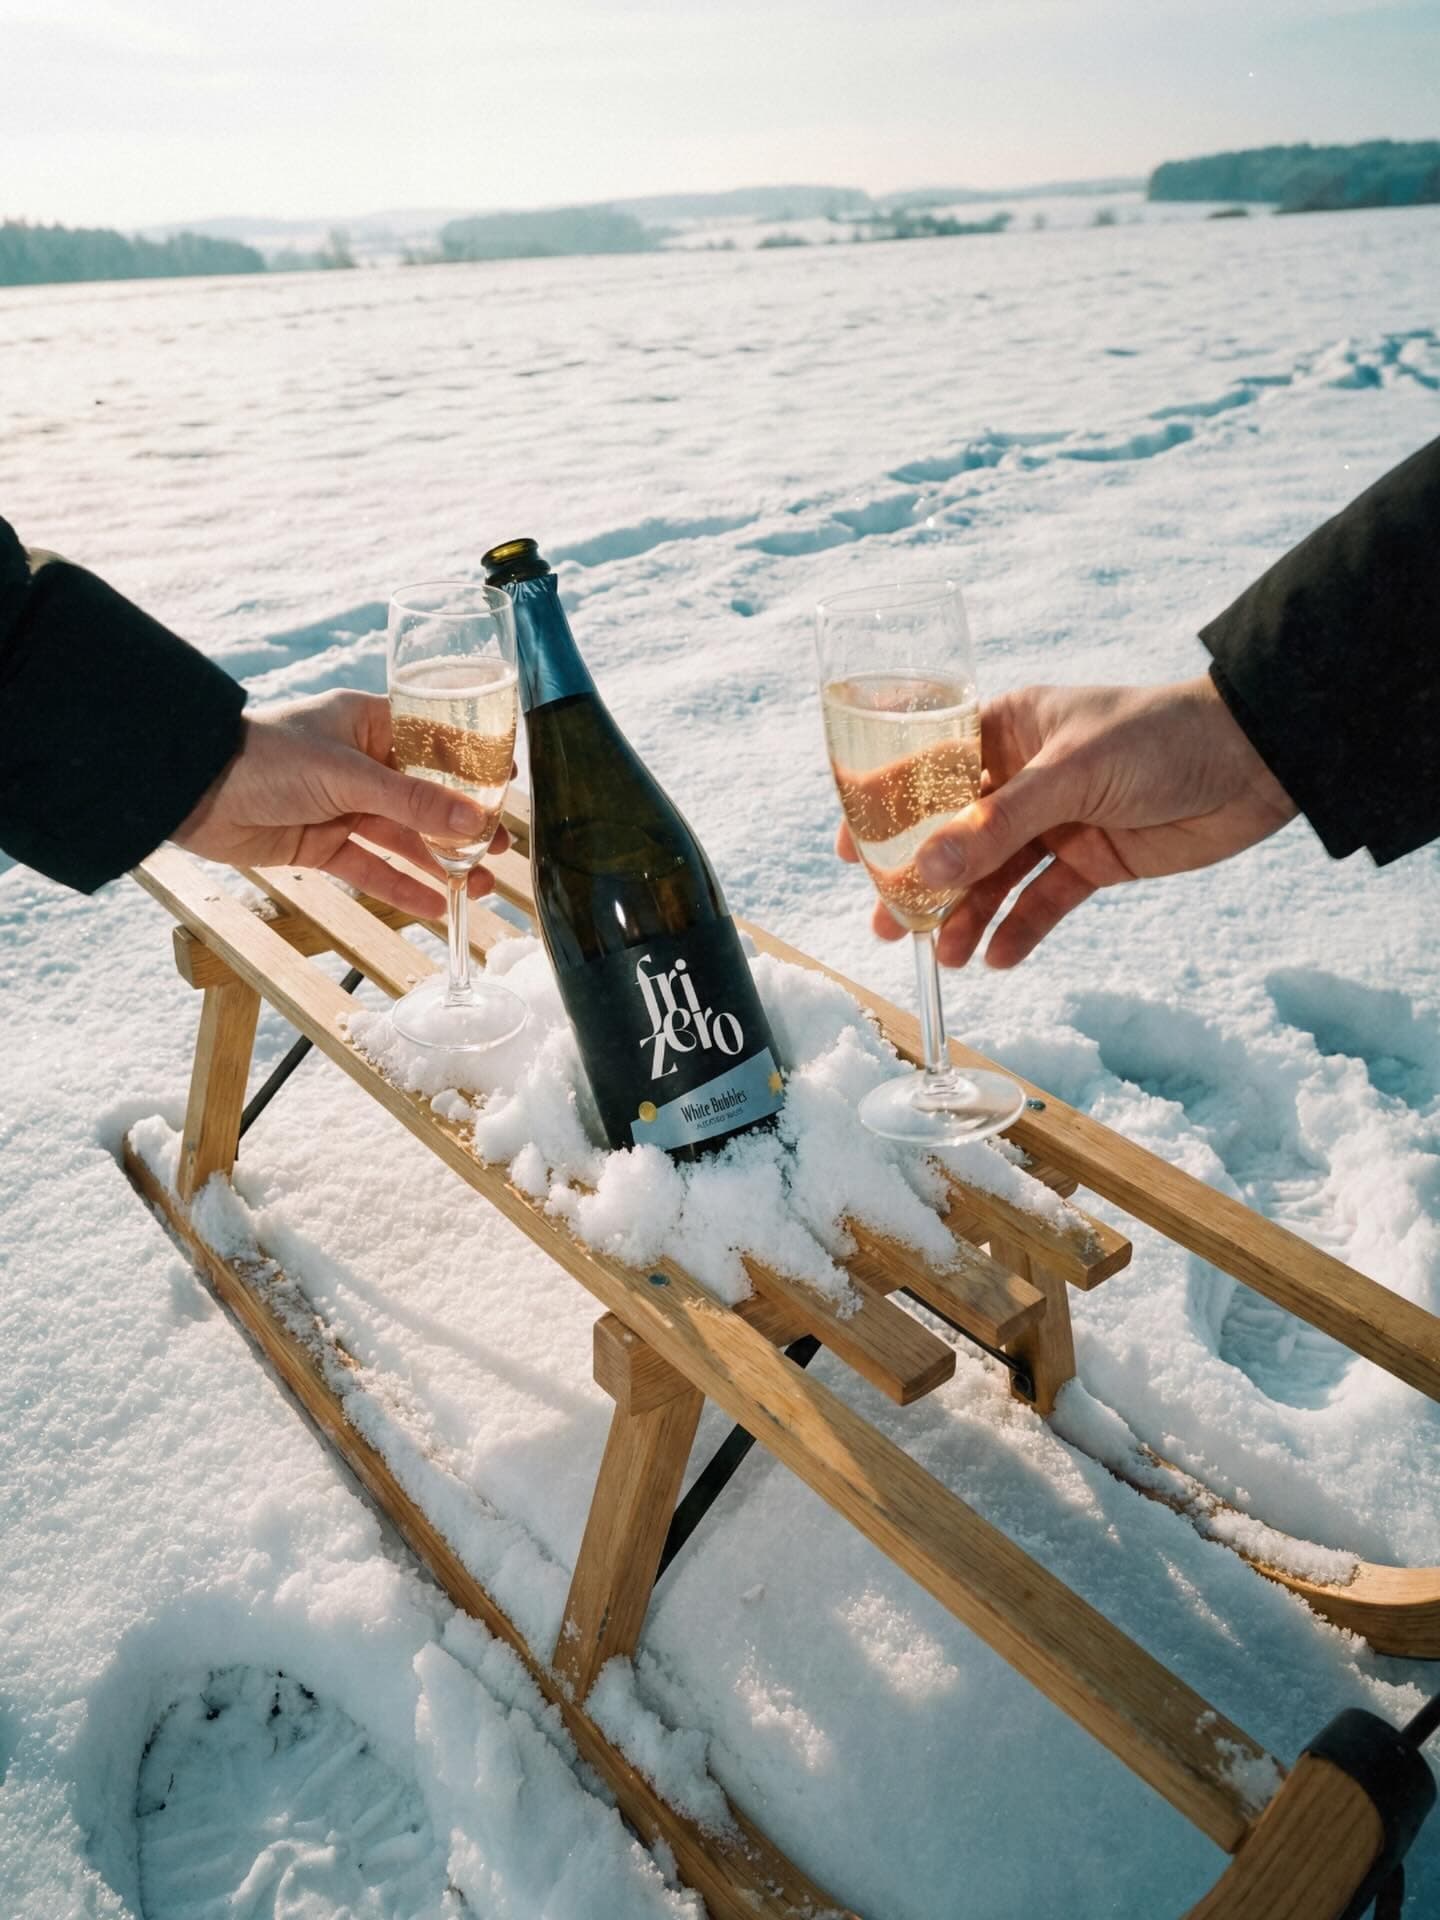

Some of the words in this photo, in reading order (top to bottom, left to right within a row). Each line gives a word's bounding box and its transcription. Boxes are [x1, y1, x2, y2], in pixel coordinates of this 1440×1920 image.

[635, 954, 701, 1034] fri
[639, 1007, 744, 1080] zero
[680, 1103, 711, 1123] White
[710, 1088, 748, 1113] Bubbles
